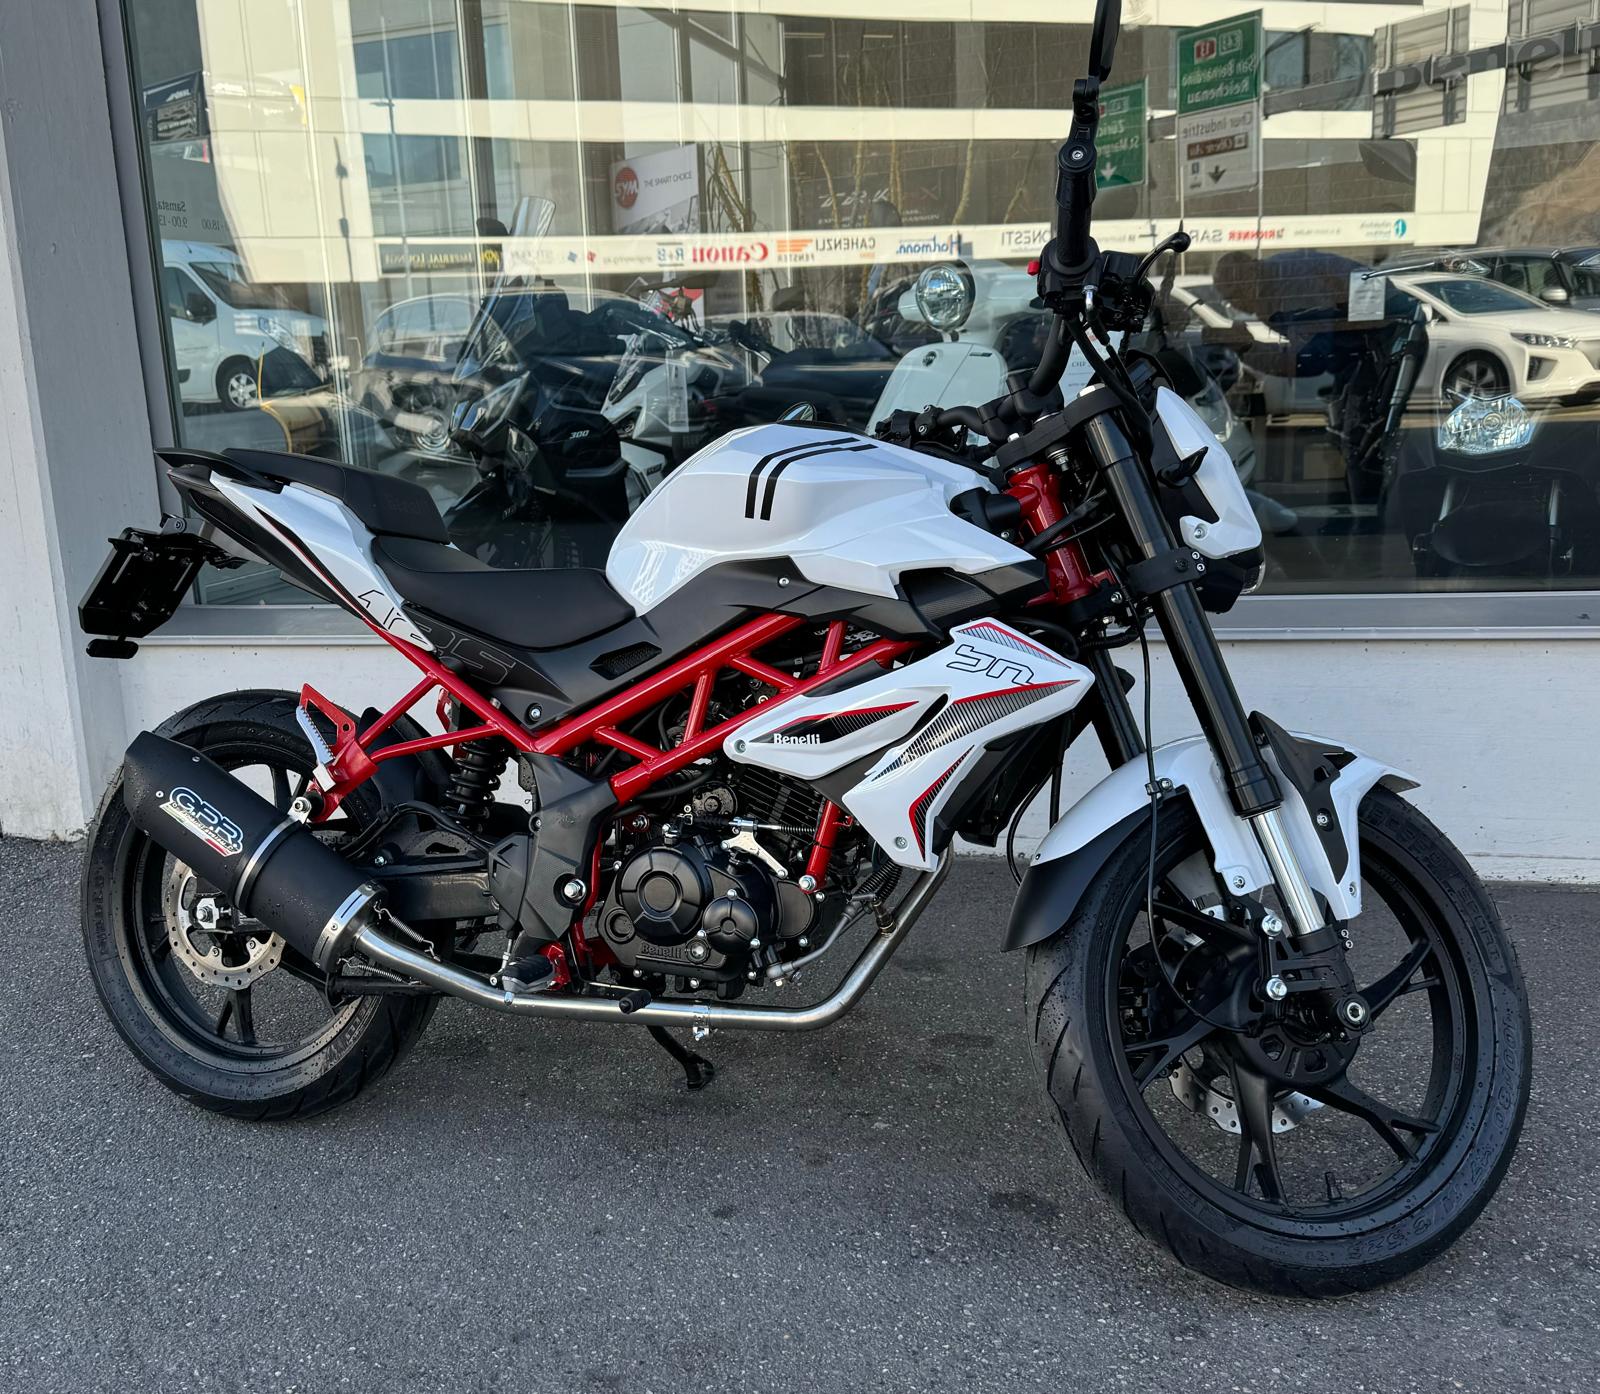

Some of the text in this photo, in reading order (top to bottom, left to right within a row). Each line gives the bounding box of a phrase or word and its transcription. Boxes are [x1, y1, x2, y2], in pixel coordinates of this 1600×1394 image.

[615, 170, 693, 200] SYM THE SMART CHOICE
[569, 429, 590, 440] 300
[773, 732, 821, 745] Benelli
[641, 941, 682, 959] Benelli
